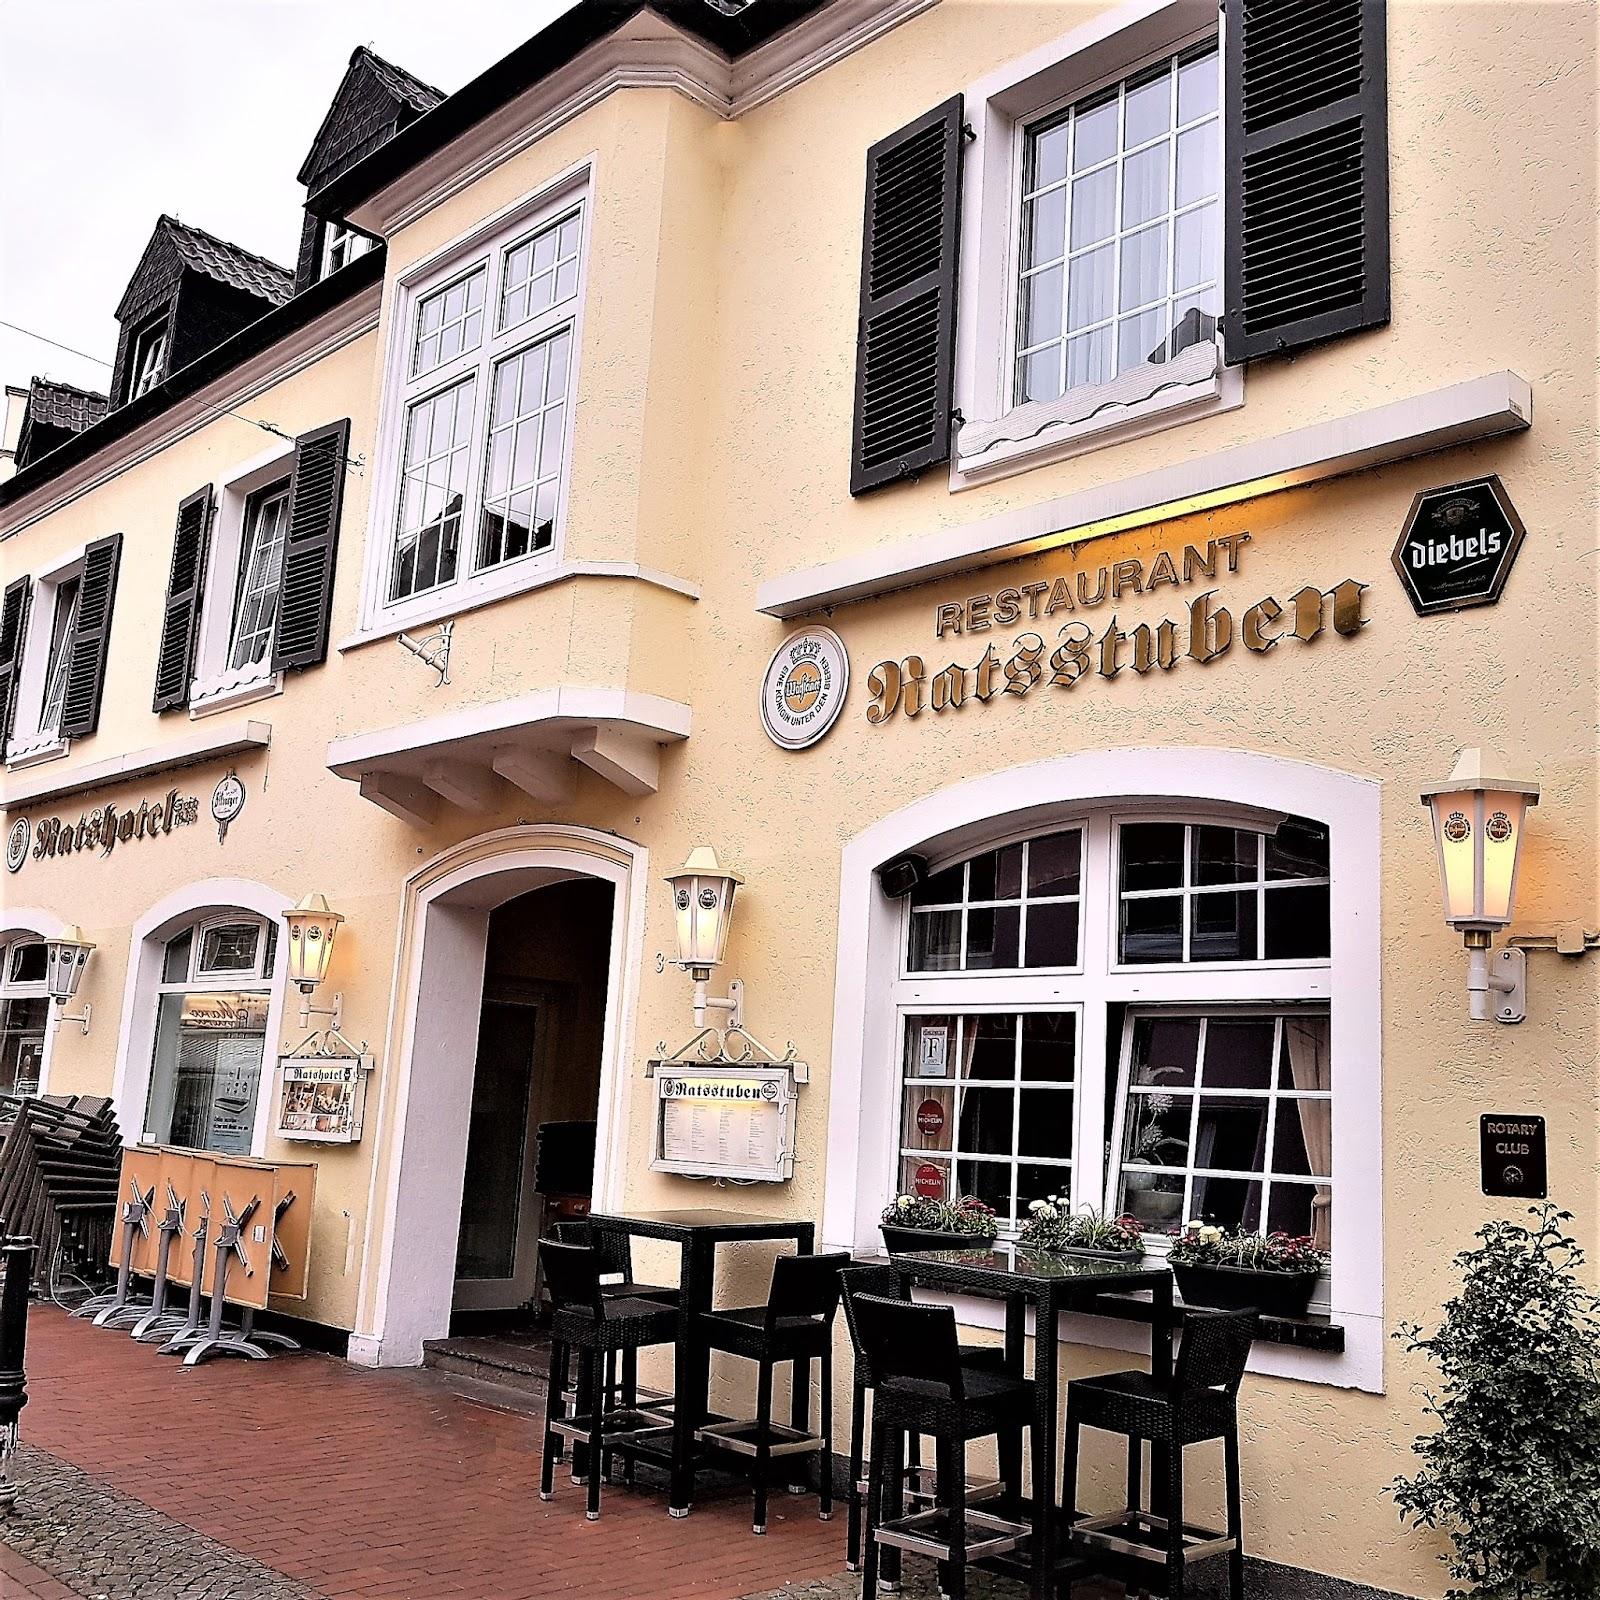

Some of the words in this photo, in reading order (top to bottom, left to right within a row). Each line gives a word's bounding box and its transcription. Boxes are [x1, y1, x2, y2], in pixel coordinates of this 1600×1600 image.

[1409, 527, 1501, 569] diebels
[935, 530, 1252, 639] RESTAURANT
[865, 578, 1371, 725] Ratsstuben
[776, 665, 789, 688] EINE
[820, 656, 832, 691] BIEREN
[775, 689, 791, 723] KÖNIGIN
[815, 692, 829, 713] DEN
[791, 711, 816, 726] UNTER
[33, 788, 179, 859] Ratshotel
[927, 1037, 940, 1058] F
[293, 1068, 343, 1081] Ratshotel
[675, 1082, 761, 1099] Ratsstuben
[918, 1116, 943, 1124] MICHELIN
[1487, 1122, 1538, 1136] ROTARY
[1495, 1142, 1530, 1155] CLUB
[915, 1178, 942, 1186] MICHELIN
